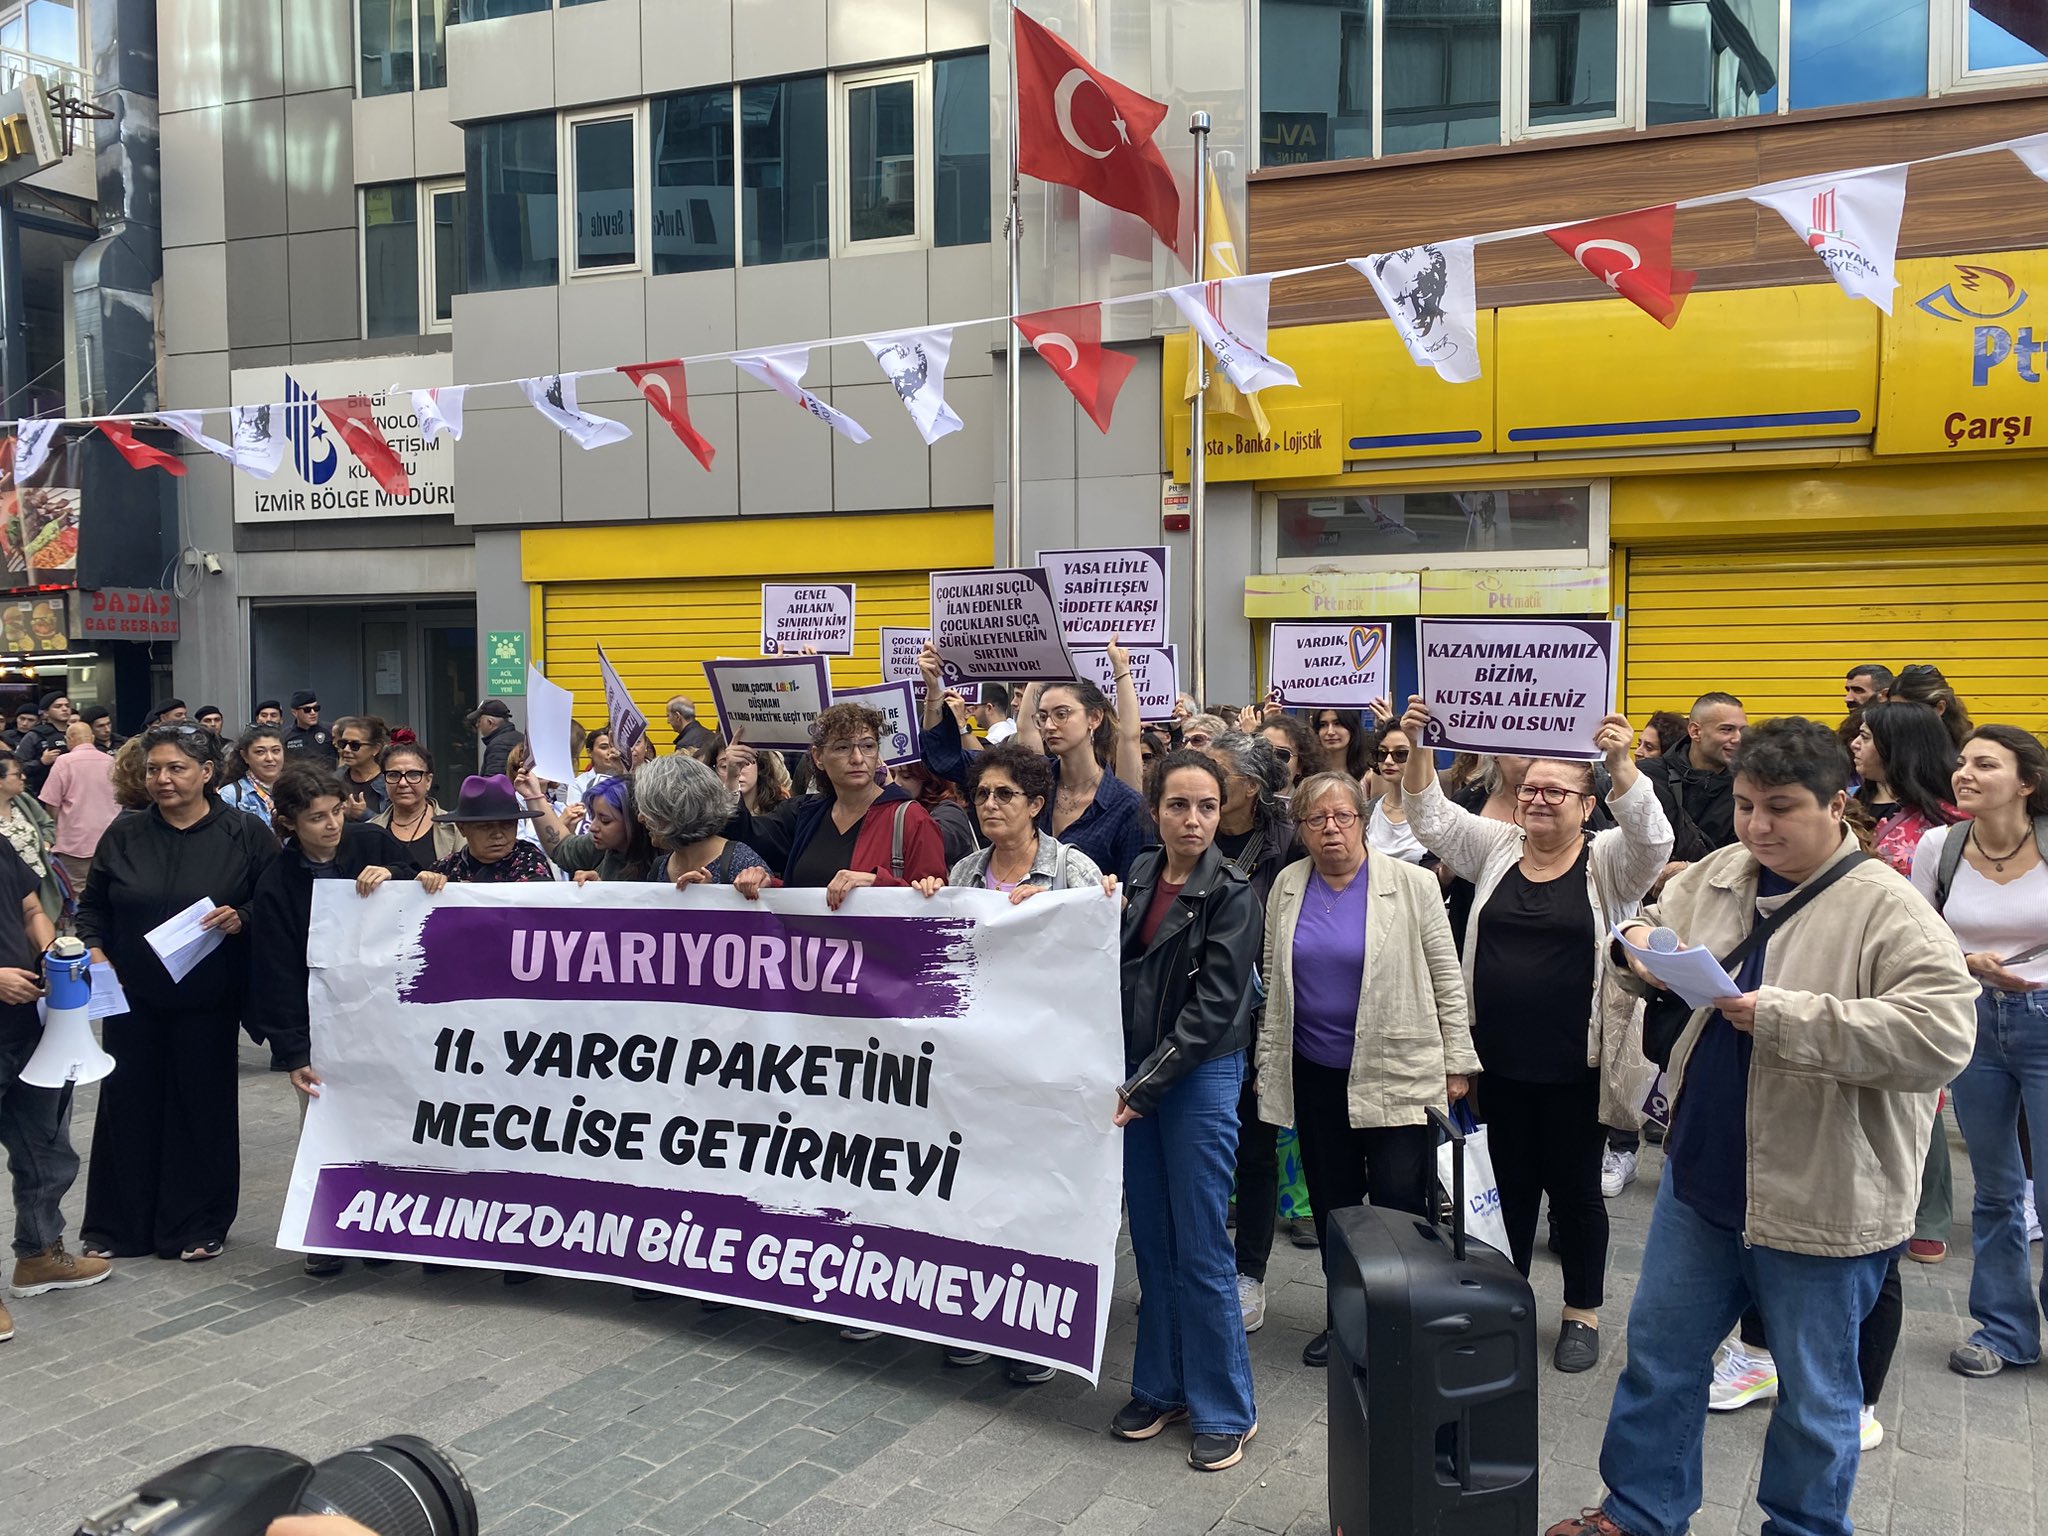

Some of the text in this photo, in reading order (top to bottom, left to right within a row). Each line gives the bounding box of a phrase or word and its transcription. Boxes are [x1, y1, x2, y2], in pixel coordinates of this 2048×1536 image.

[1972, 326, 2048, 386] Pt
[1944, 412, 2032, 448] Çarşı
[1235, 432, 1271, 455] Banka
[1283, 428, 1322, 455] Lojistik
[255, 489, 305, 512] İZMİR
[311, 487, 369, 509] BÖLGE
[1063, 558, 1150, 575] YASA ELİYLE
[794, 589, 827, 600] GENEL
[936, 580, 1035, 602] ÇOCUKLARI SUÇLU
[1064, 578, 1149, 596] SABİTLEŞEN
[786, 603, 835, 614] AHLAKIN
[947, 598, 1023, 615] İLAN EDENLER
[1114, 600, 1158, 616] KARŞI
[777, 613, 847, 628] SINIRINI KİM
[940, 613, 1040, 635] ÇOCUKLARI SUÇA
[776, 628, 846, 641] BELİRLİYOR?
[939, 627, 1048, 648] SÜRÜKLEYENLERİN
[1296, 635, 1348, 649] VARDIK,
[973, 647, 1018, 660] SIRTINI
[1128, 655, 1150, 665] RGI
[1427, 643, 1600, 659] KAZANIMLARIMIZ
[968, 660, 1041, 673] SIVAZLIYOR!
[1304, 655, 1346, 669] VARIZ,
[1281, 672, 1375, 690] VAROLACAĞIZ!
[1474, 664, 1538, 685] BİZİM,
[748, 697, 780, 711] DÜŞMANI
[1435, 688, 1587, 708] KUTSAL AİLENİZ
[782, 710, 801, 725] GEÇİT
[1448, 710, 1576, 732] SİZİN OLSUN!
[509, 929, 864, 994] UYARIYORUZ!
[433, 1027, 935, 1109] 11. YARGI PAKETİNİ
[412, 1095, 962, 1202] MECLİSE GETİRMEYİ
[336, 1190, 1078, 1340] AKLINIZDAN BİLE GEÇİRMEYİN!
